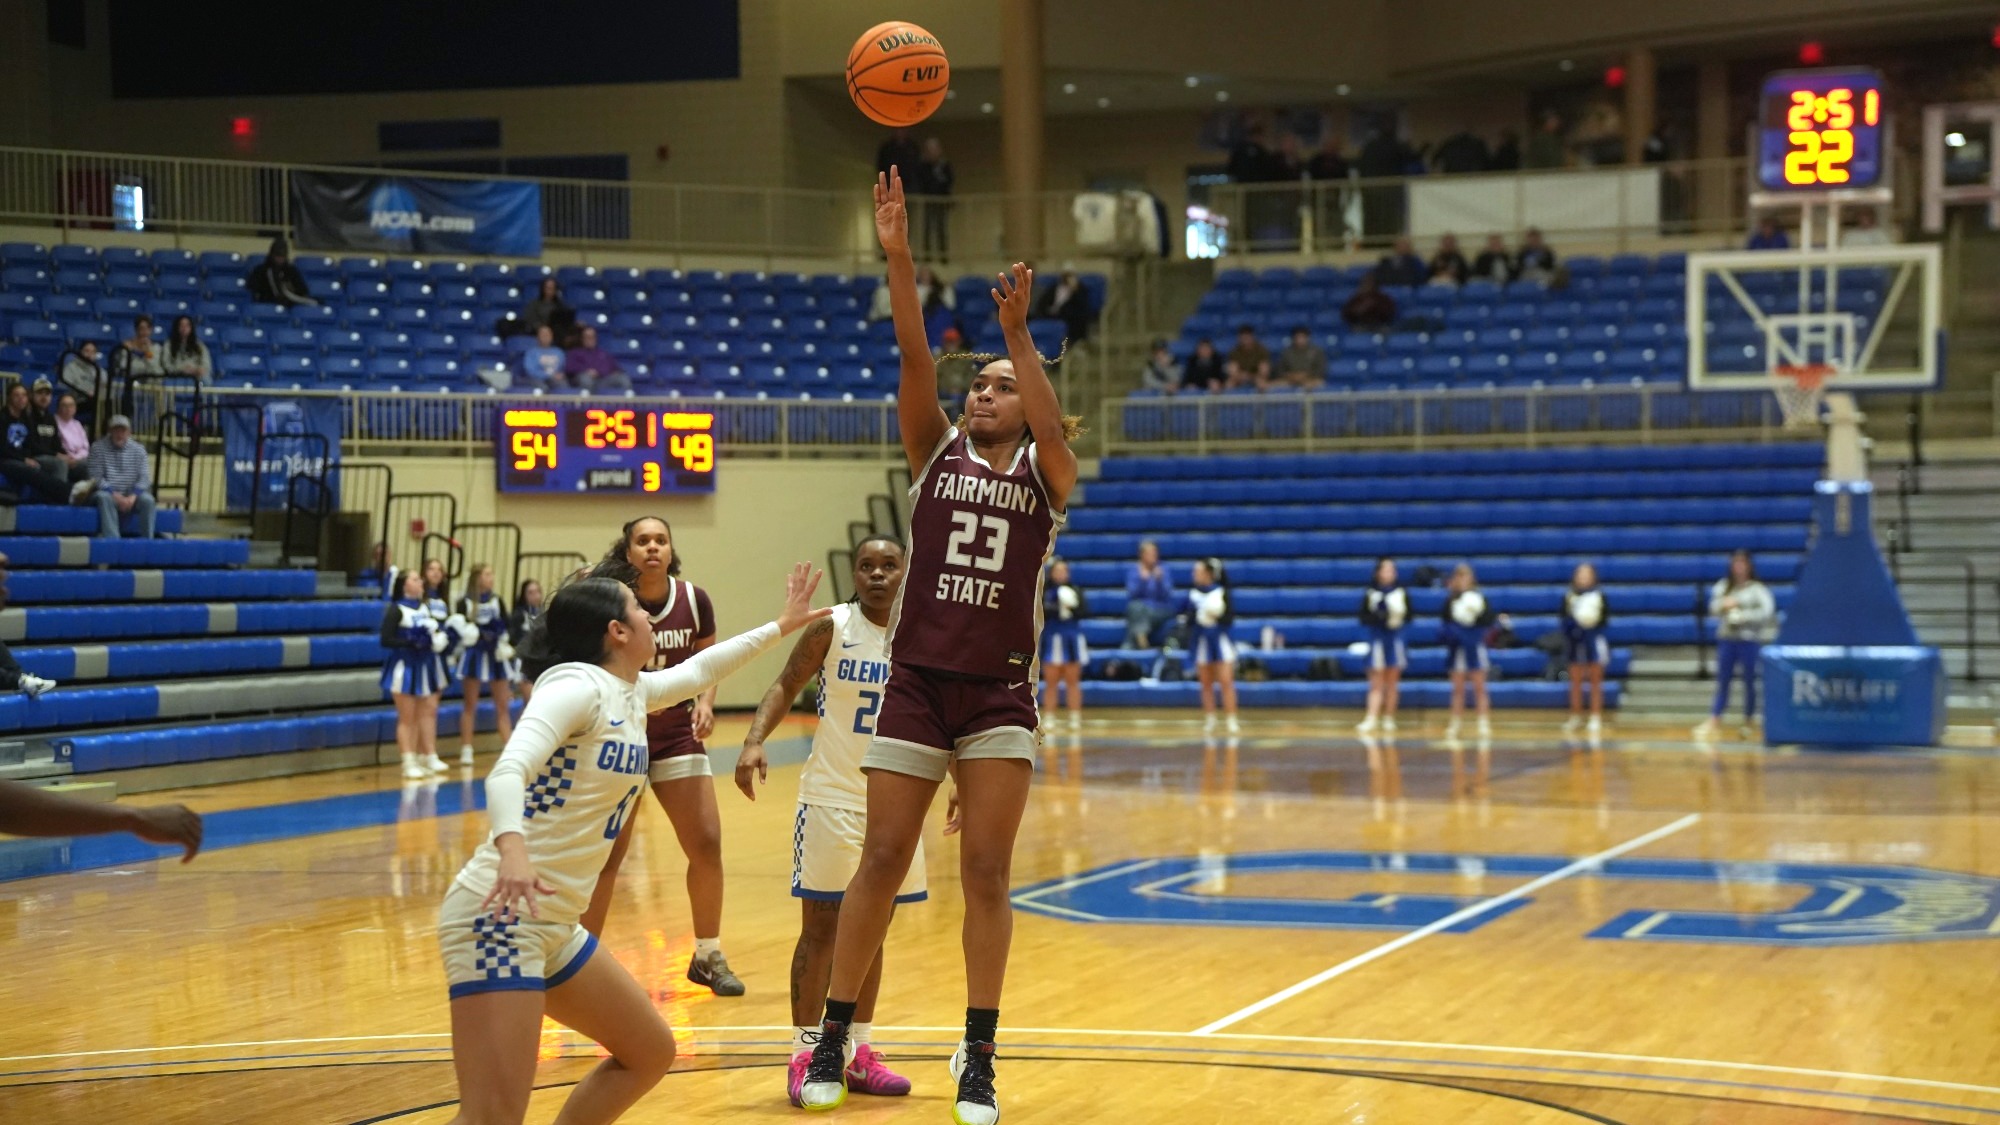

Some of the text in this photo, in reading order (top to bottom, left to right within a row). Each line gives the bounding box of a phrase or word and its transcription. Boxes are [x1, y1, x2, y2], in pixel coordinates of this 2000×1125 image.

[877, 31, 942, 53] Wilson
[902, 65, 939, 83] EVO
[1787, 88, 1880, 131] 2:51
[1784, 129, 1854, 185] 22
[370, 211, 475, 233] NCAA.com
[584, 409, 657, 449] 2:51
[233, 460, 270, 473] MAE
[512, 431, 557, 471] 54
[670, 433, 714, 473] 49
[643, 461, 661, 492] 3
[945, 510, 1010, 573] 23
[936, 573, 1005, 610] STATE
[852, 689, 881, 735] 2
